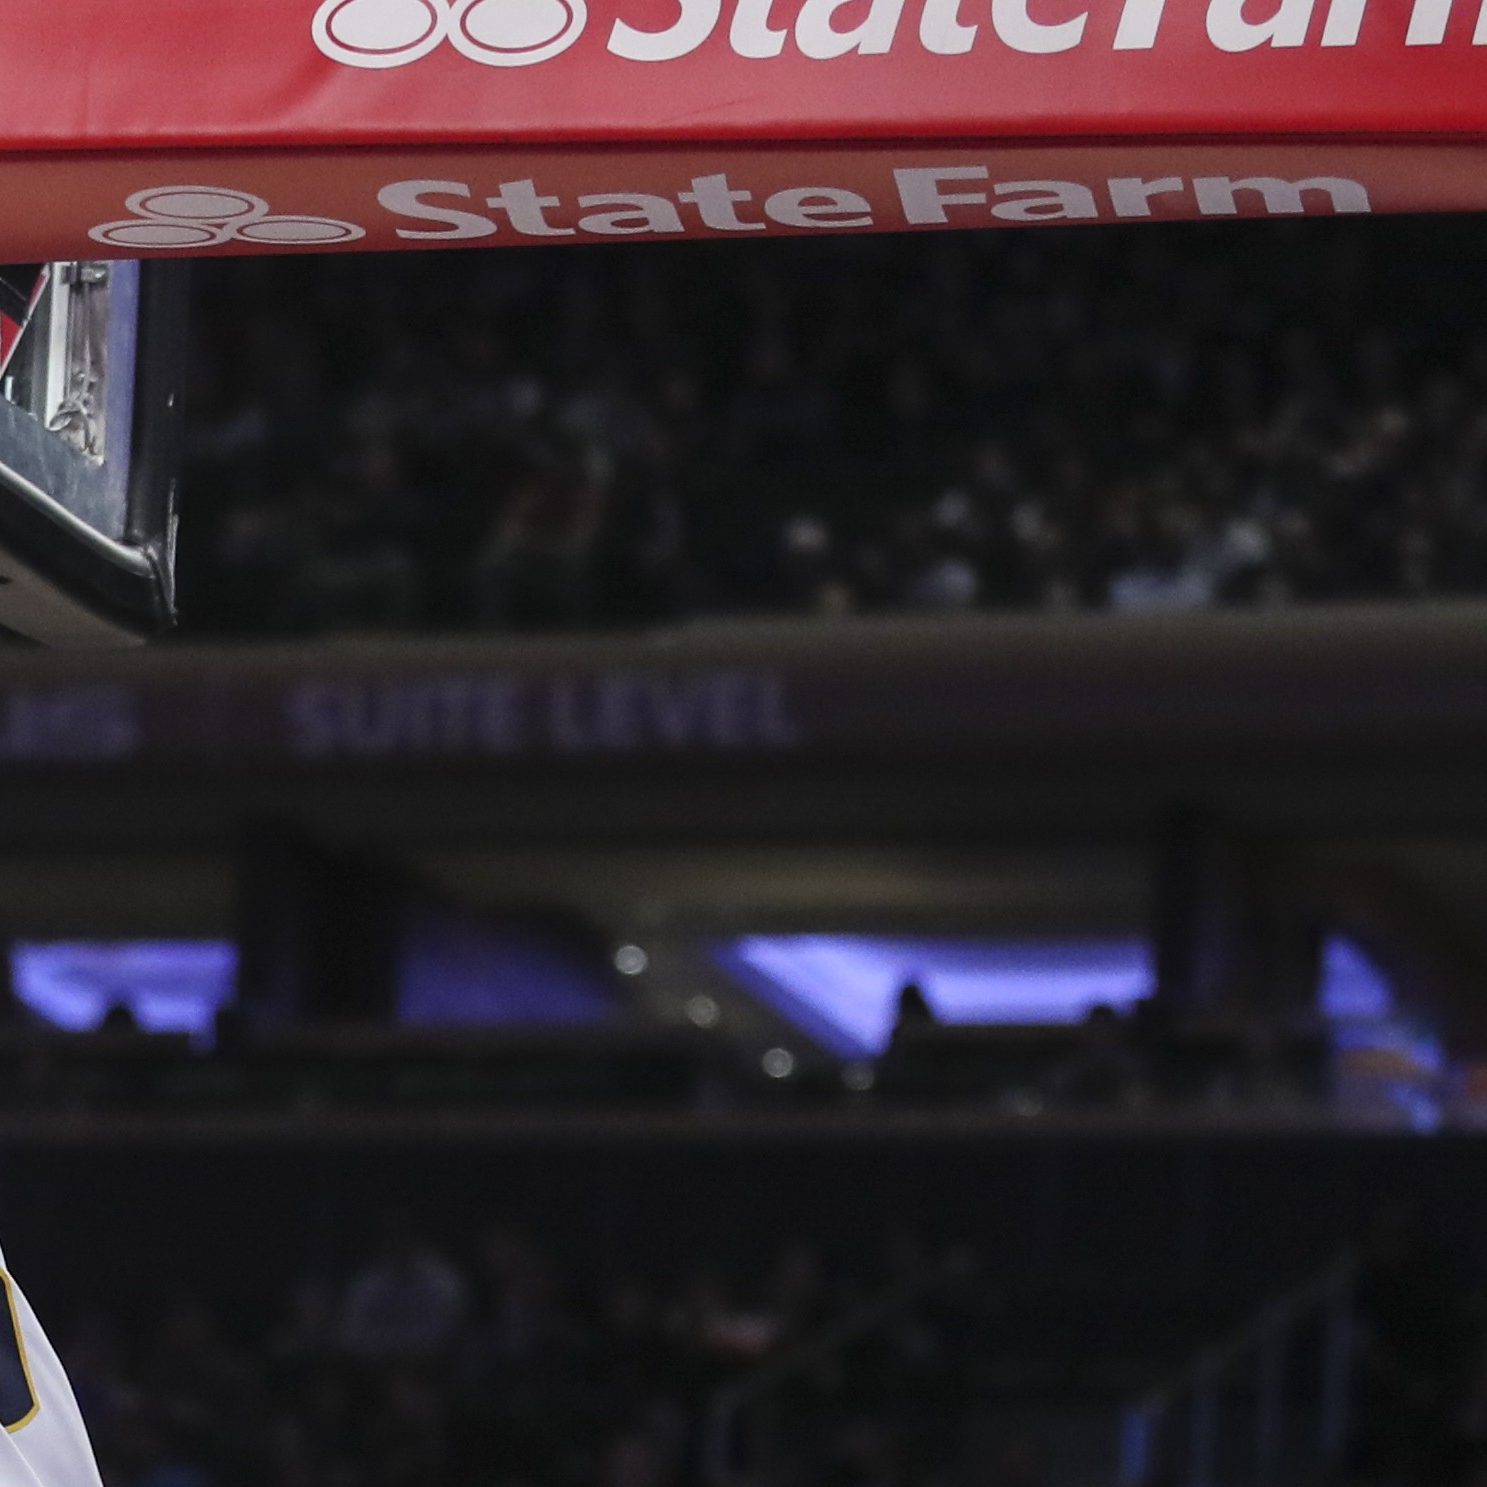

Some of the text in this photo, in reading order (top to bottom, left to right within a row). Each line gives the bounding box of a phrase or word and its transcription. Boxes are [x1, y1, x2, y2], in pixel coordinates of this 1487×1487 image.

[376, 165, 1372, 240] State Farm
[281, 673, 523, 760] SUITE
[545, 668, 805, 754] LEVEL
